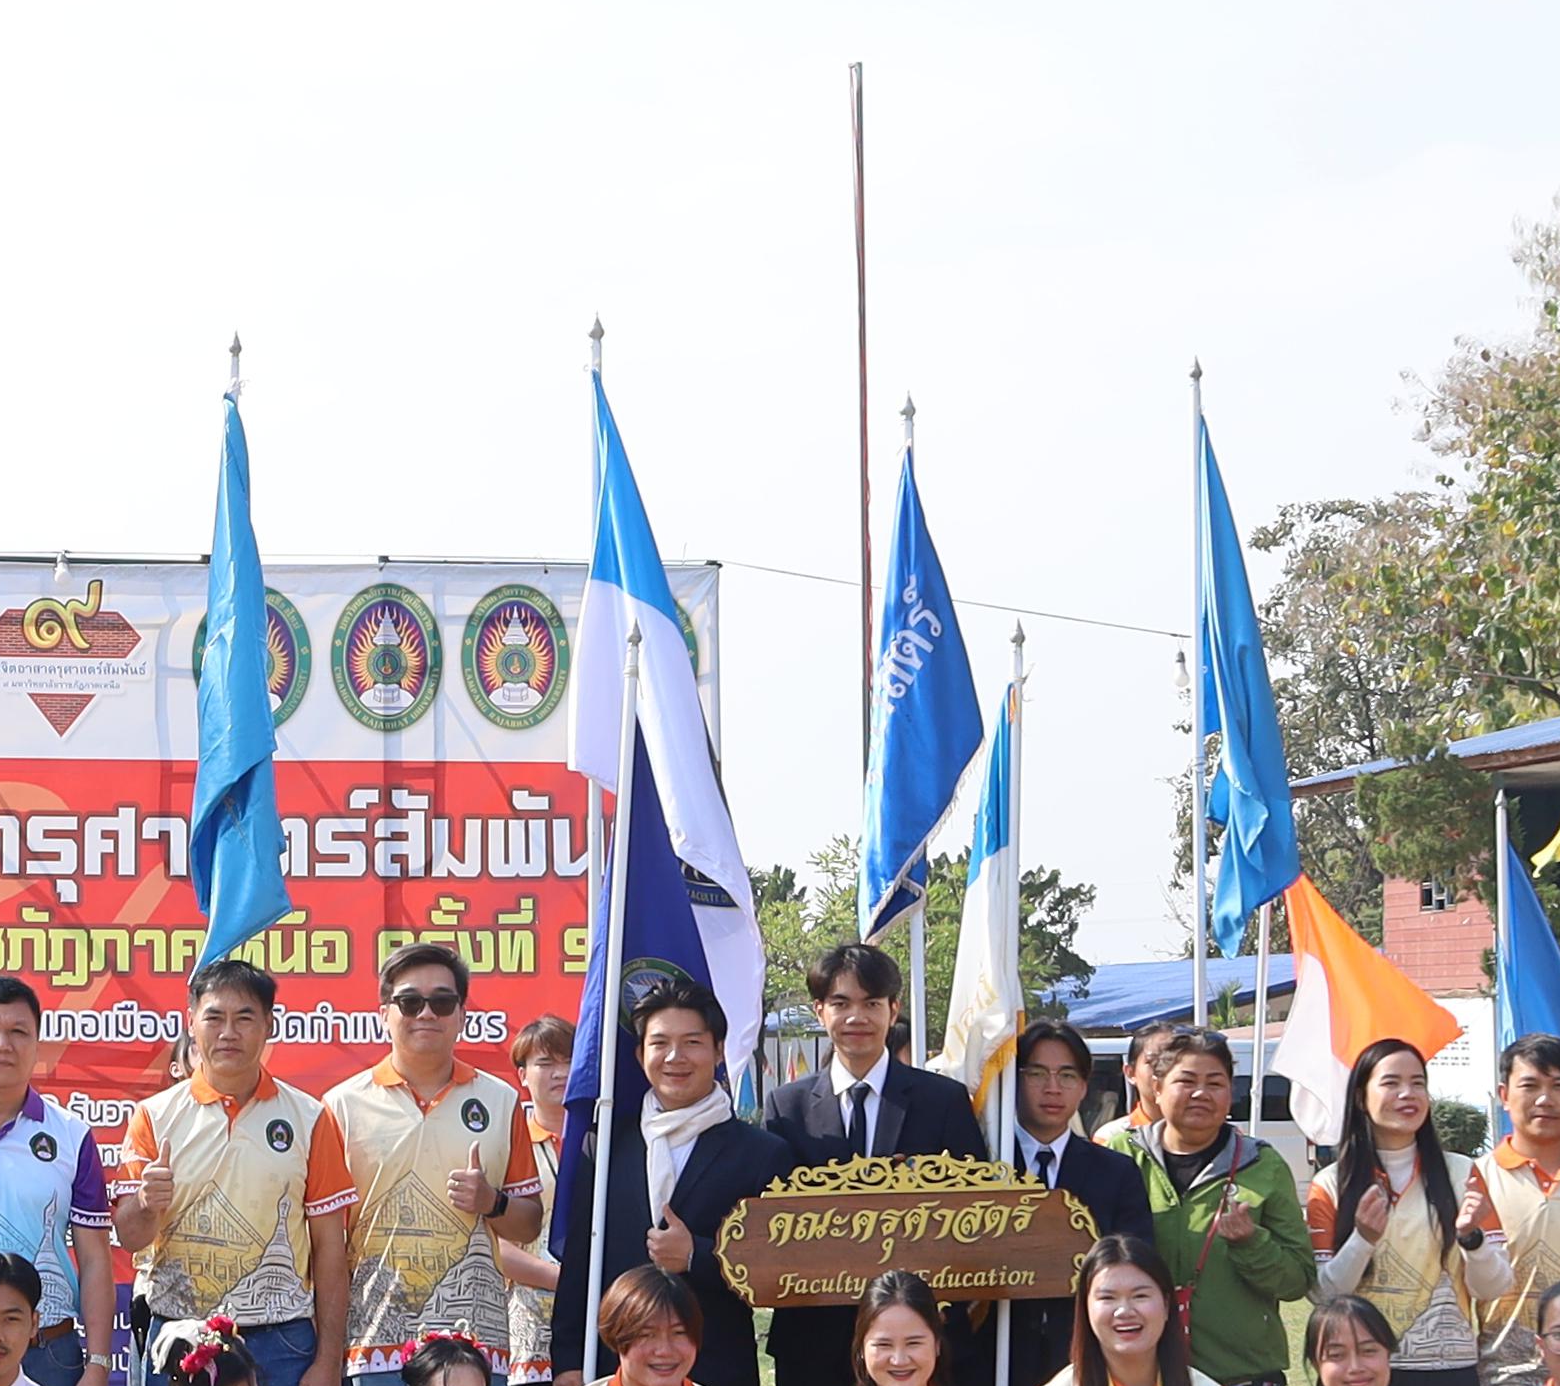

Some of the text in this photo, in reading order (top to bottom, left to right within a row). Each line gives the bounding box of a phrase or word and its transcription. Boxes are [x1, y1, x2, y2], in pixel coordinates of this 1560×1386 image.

[767, 1190, 1049, 1264] คณะครุศาสตร์
[777, 1271, 867, 1300] Faculty
